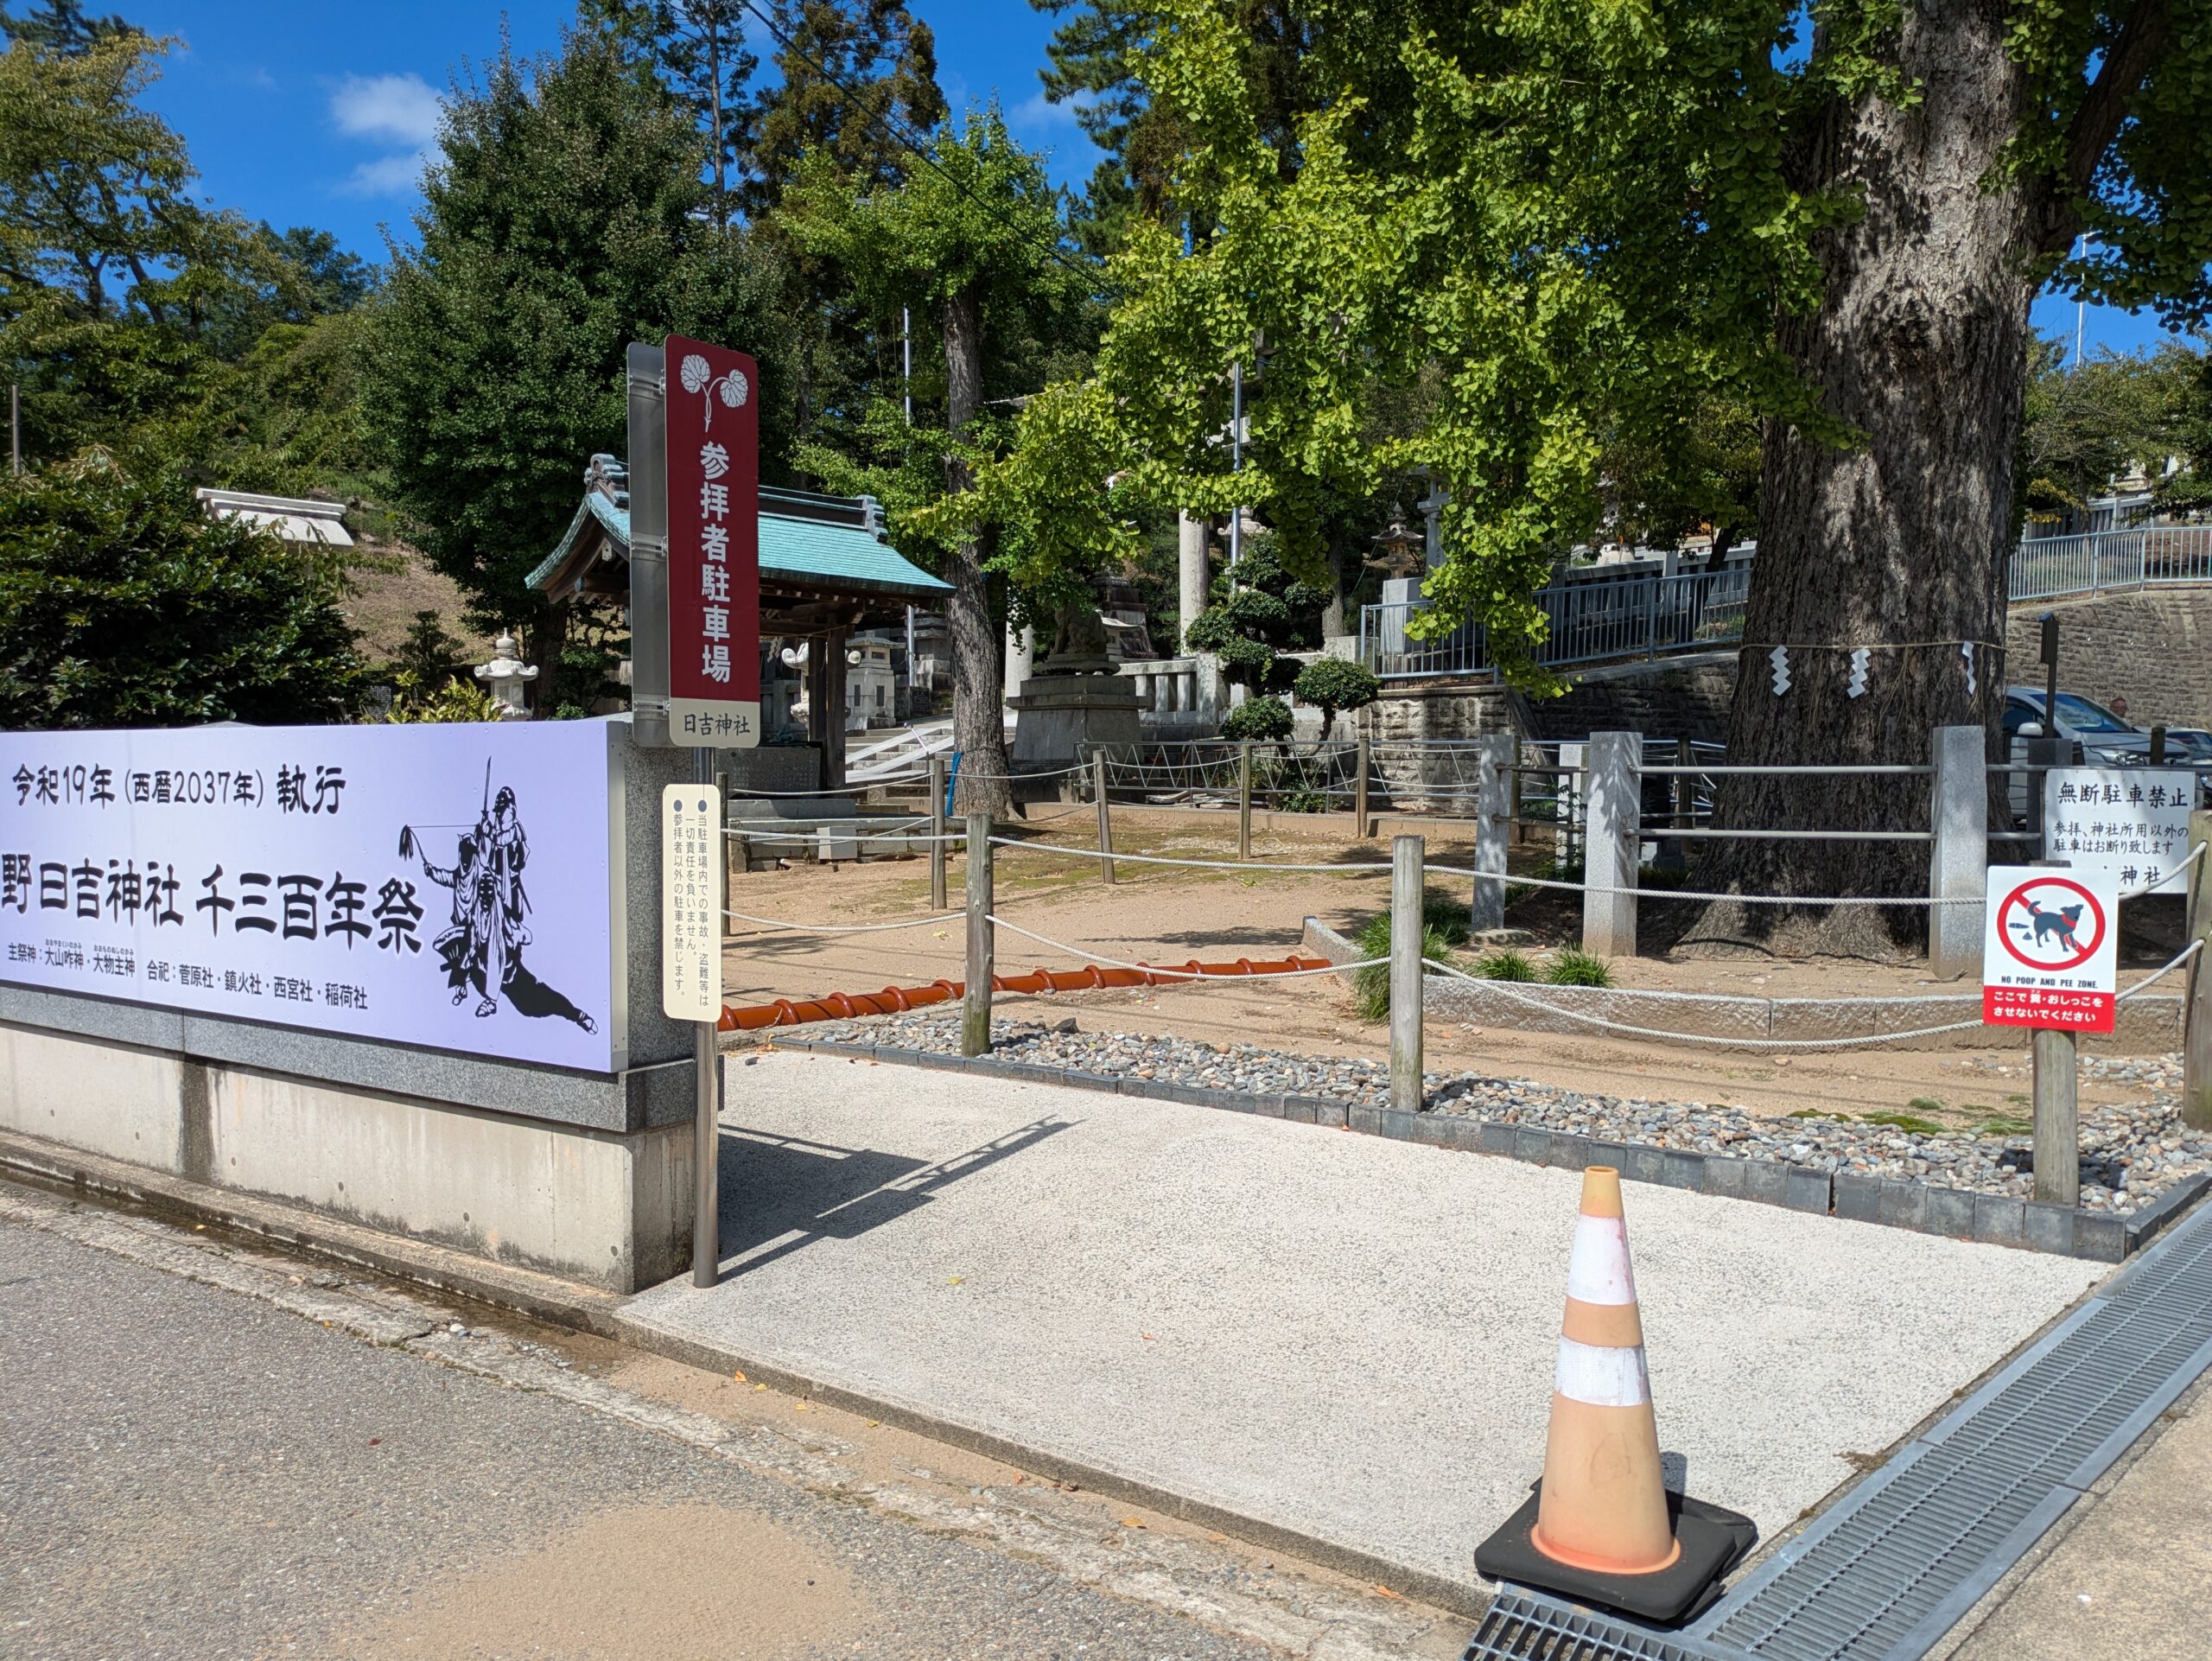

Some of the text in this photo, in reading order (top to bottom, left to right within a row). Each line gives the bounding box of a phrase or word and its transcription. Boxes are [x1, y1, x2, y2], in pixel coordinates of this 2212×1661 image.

[700, 442, 731, 684] 参拝者駐車場
[683, 713, 751, 737] 日吉神社
[2057, 781, 2188, 809] 無断駐車禁止
[2053, 820, 2189, 839] 参拝、神社所用以外の
[2053, 837, 2174, 856] 駐車はお断り致します
[686, 818, 697, 956] 一切責任を負いません。
[2104, 865, 2160, 887] 神社
[673, 813, 685, 996] 参拝者以外の駐車を禁じます。
[697, 814, 709, 1007] 当駐車場内での事故・盗難等は
[2016, 977, 2036, 985] POOP
[2040, 977, 2056, 986] AND
[1993, 1007, 2096, 1022] させないでください
